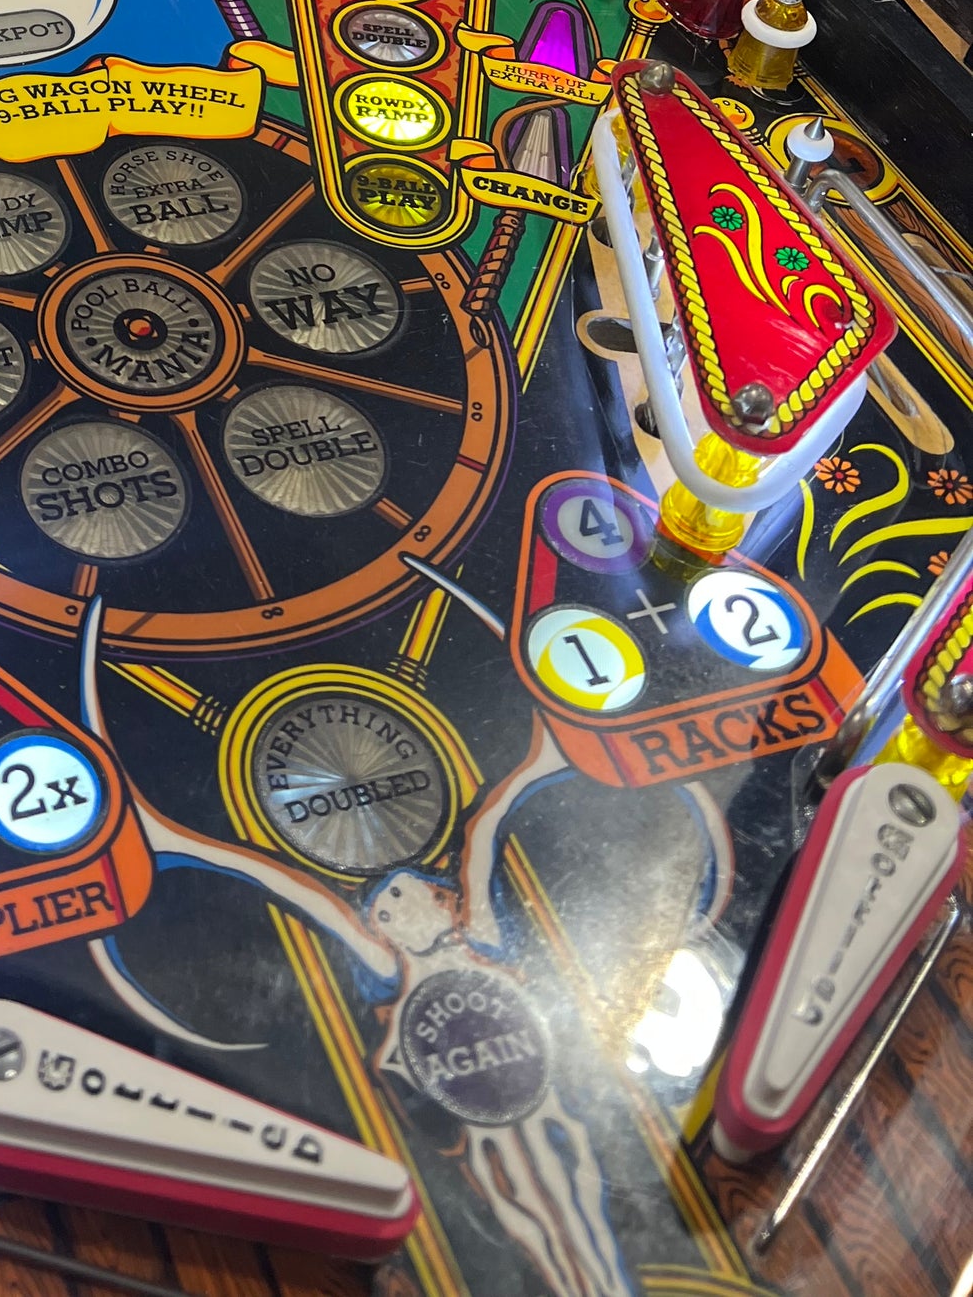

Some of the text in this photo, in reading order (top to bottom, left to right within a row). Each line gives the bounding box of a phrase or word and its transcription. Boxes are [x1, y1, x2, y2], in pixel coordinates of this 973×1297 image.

[351, 31, 427, 49] DOUBLE
[362, 23, 415, 37] SPELL
[23, 79, 133, 99] WAGON
[141, 81, 246, 109] WHEEL
[488, 68, 601, 103] EXTRA BALL
[505, 63, 588, 91] HURRY UP
[0, 98, 101, 125] 9-BALL
[109, 98, 206, 119] PLAY!!
[354, 93, 429, 113] ROWDY
[355, 105, 429, 125] RAMP
[111, 150, 225, 196] HORSE SHOE
[132, 178, 205, 199] EXTRA
[357, 175, 432, 194] 9-BALL
[129, 194, 230, 225] BALL
[358, 189, 437, 211] PLAY
[471, 176, 589, 213] CHANGE
[290, 263, 337, 285] NO
[71, 278, 192, 332] POOL BALL
[265, 283, 386, 330] WAY
[90, 330, 210, 383] MANIA
[252, 415, 342, 447] SPELL
[42, 450, 150, 486] COMBO
[239, 433, 377, 477] DOUBLE
[39, 470, 178, 522] SHOTS
[579, 498, 615, 545] 4
[573, 635, 609, 684] 1
[726, 593, 781, 645] 2
[266, 704, 418, 792] EVERYTHING
[631, 688, 828, 775] RACKS
[0, 763, 90, 821] 2x
[284, 769, 431, 823] DOUBLED
[416, 991, 513, 1044] SHOOT
[423, 1028, 539, 1087] AGAIN
